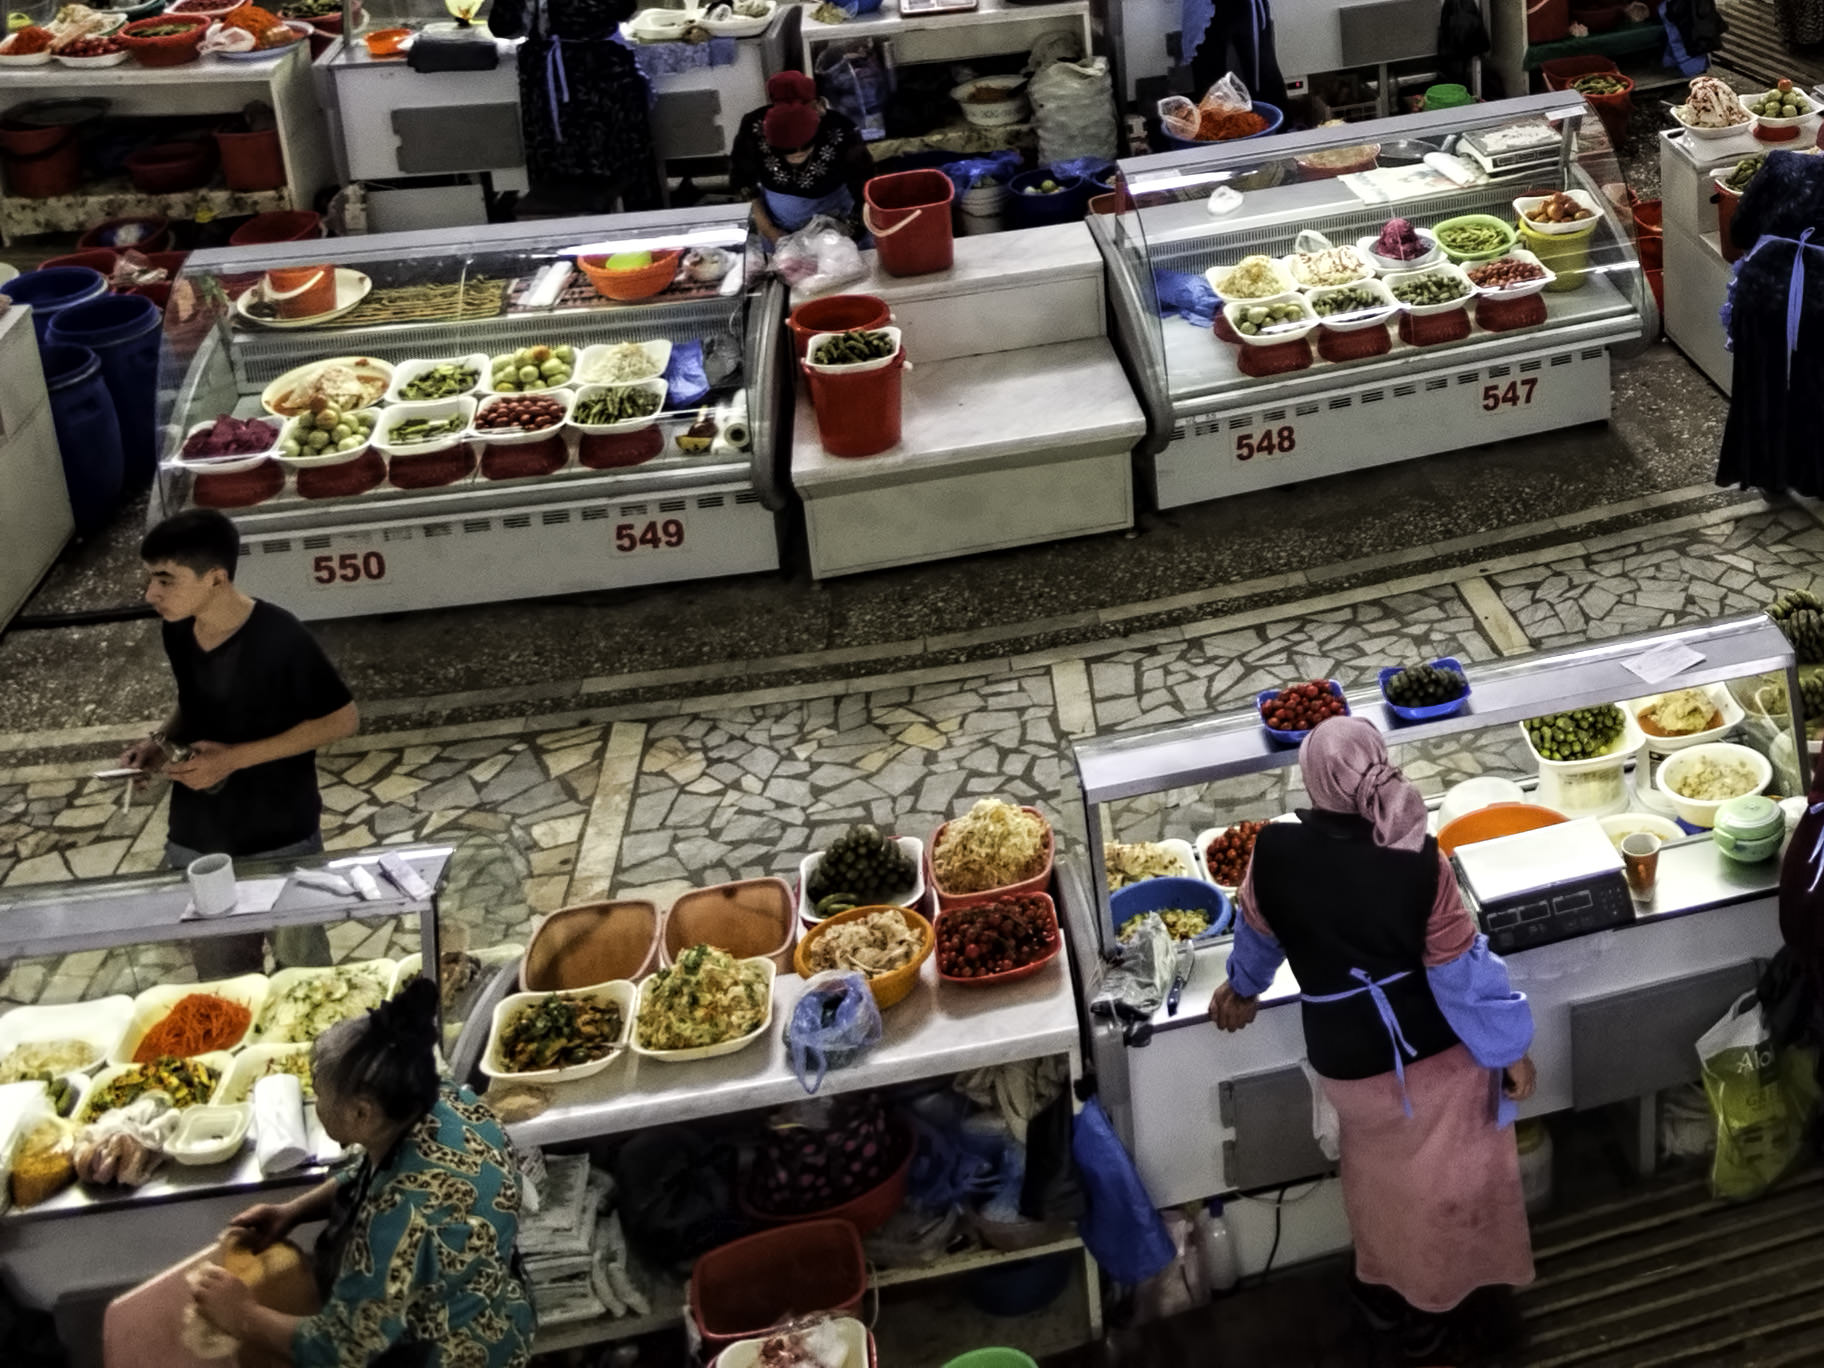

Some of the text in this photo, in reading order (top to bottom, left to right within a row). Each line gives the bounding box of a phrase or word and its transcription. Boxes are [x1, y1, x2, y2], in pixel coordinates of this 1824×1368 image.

[1482, 377, 1538, 411] 547
[1236, 426, 1296, 461] 548
[615, 519, 684, 552] 549
[314, 551, 386, 584] 550
